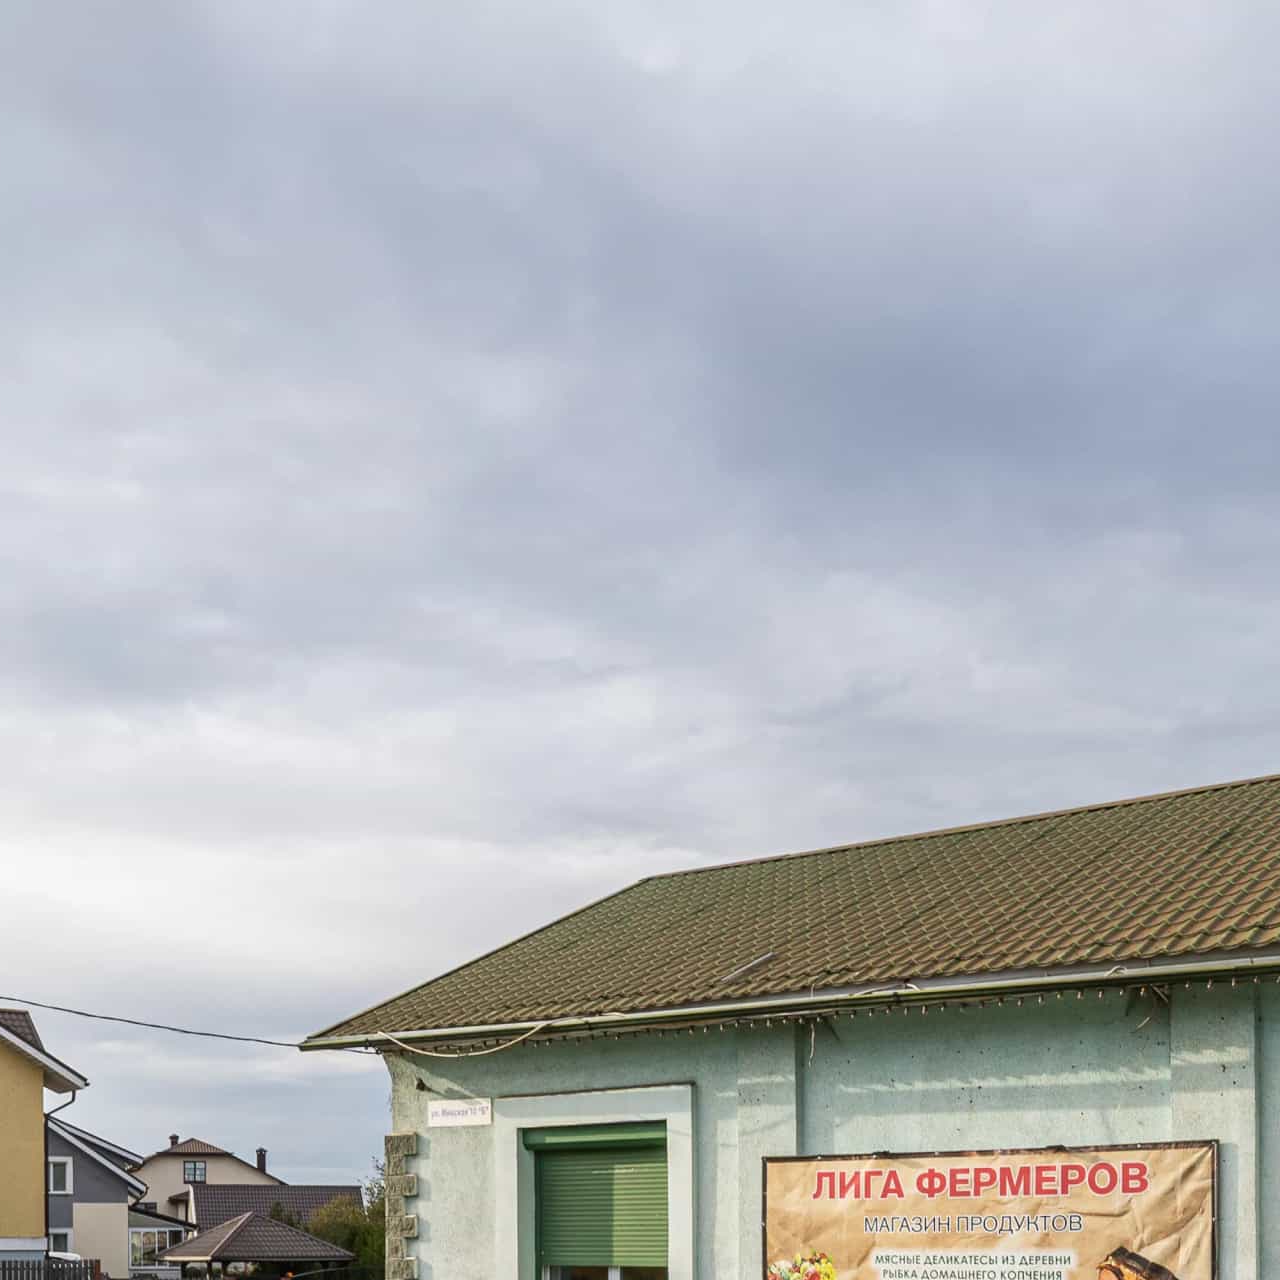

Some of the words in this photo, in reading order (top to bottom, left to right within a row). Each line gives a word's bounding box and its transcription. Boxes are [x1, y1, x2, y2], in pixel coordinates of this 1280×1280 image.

[812, 1170, 905, 1200] ЛИГА
[916, 1162, 1149, 1198] ФЕРМЕРОВ
[863, 1216, 951, 1233] МАГАЗИН
[956, 1214, 1083, 1235] ПРОДУКТОВ
[875, 1255, 921, 1265] МЯСНЫЕ
[923, 1255, 998, 1266] ДЕЛИКАТЕСЫ
[1001, 1255, 1016, 1265] ИЗ
[1019, 1255, 1071, 1266] ДЕРЕВНИ
[882, 1269, 918, 1279] РЫБКА
[921, 1269, 997, 1280] ДОМАШНЕГО
[1000, 1270, 1062, 1280] КОПЧЕНИЯ
